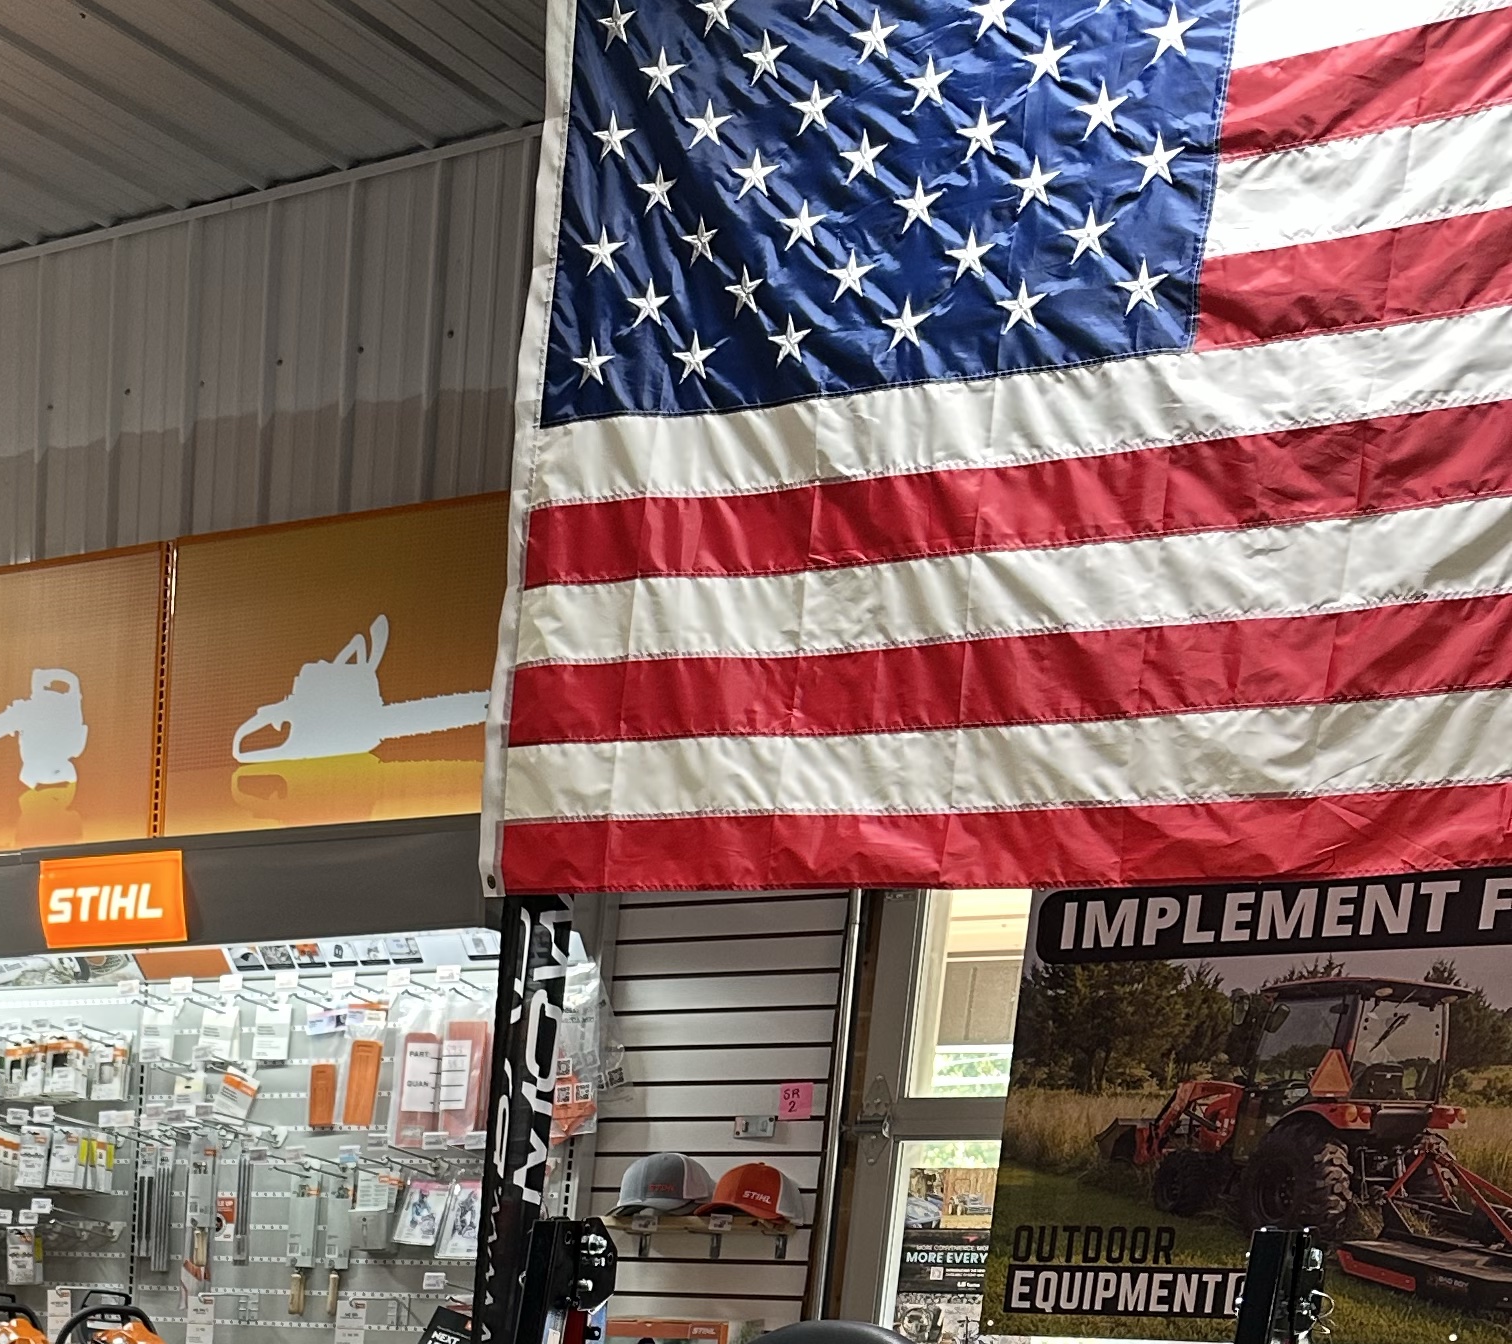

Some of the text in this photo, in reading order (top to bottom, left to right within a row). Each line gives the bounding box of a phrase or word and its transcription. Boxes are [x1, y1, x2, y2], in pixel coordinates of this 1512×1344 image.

[48, 883, 163, 924] STIHL
[1059, 880, 1460, 951] IMPLEMENT
[409, 1050, 430, 1058] PART
[788, 1100, 798, 1112] 2
[742, 1190, 772, 1205] STIHL
[1012, 1225, 1176, 1265] OUTDOOR
[906, 1252, 988, 1264] MORE EVERY
[1011, 1270, 1223, 1314] EQUIPMENT
[691, 1326, 716, 1336] STIHL
